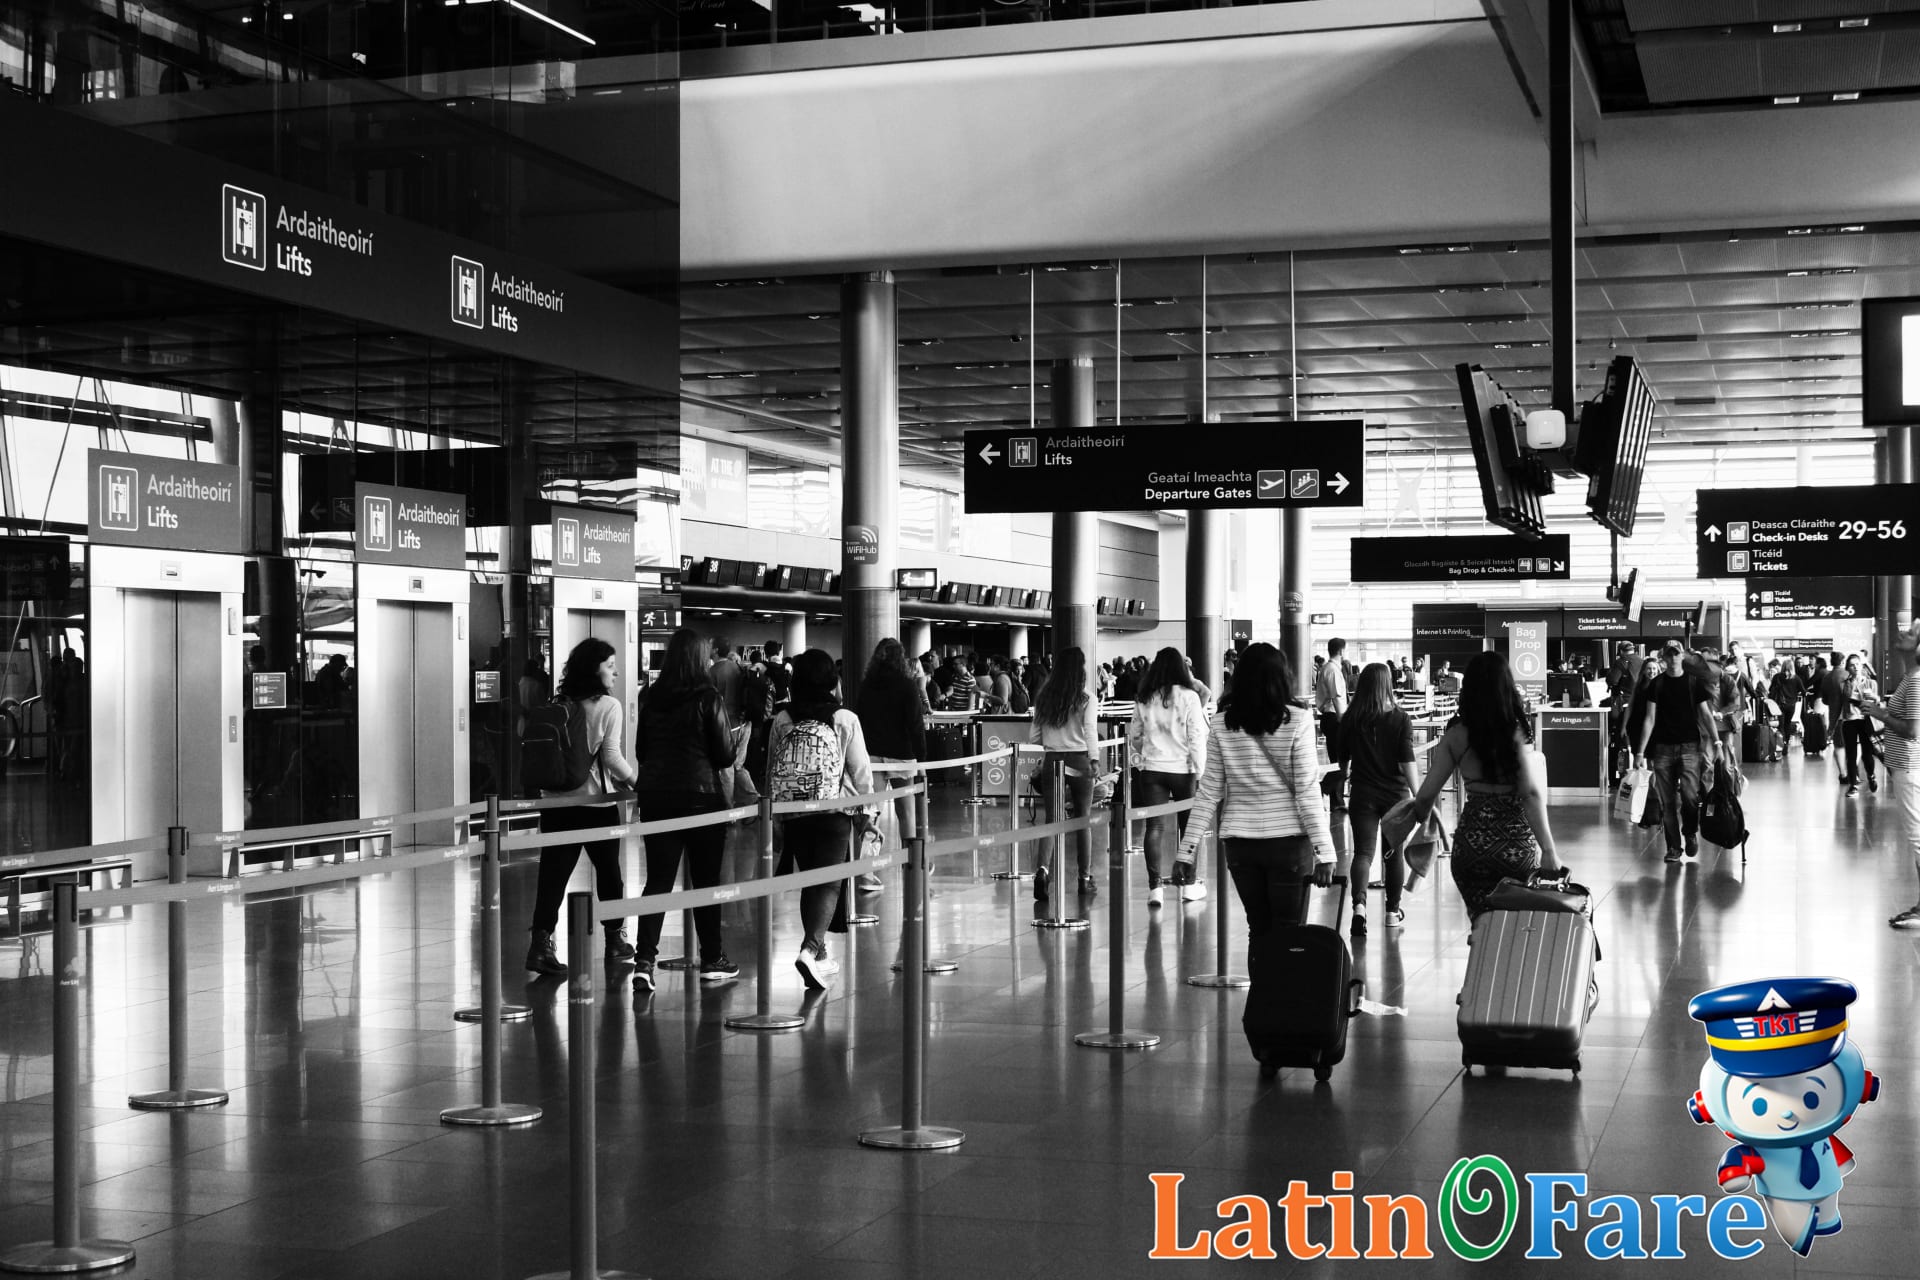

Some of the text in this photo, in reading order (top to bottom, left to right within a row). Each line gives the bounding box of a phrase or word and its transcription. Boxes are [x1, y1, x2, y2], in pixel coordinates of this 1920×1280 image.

[277, 205, 373, 256] Ardaitheoirí
[276, 243, 312, 276] Lifts
[491, 272, 564, 313] Ardaitheoirí
[491, 304, 518, 333] Lifts
[1046, 435, 1125, 449] Ardaitheoirí
[1045, 453, 1073, 466] Lifts
[1148, 470, 1253, 484] Geataí Imeachta
[147, 474, 231, 503] Ardaitheoirí
[1145, 486, 1253, 502] Departure Gates
[147, 505, 178, 529] Lifts
[398, 502, 459, 527] Ardaitheoirí
[1752, 519, 1836, 529] Deasca Cláraithe
[1838, 520, 1907, 540] 29-56
[398, 527, 421, 549] Lifts
[583, 523, 631, 545] Ardaitheoirí
[1752, 532, 1829, 542] Check-in Desks
[583, 545, 601, 564] Lifts
[1752, 548, 1783, 558] Ticéid
[682, 558, 692, 571] 37
[709, 559, 719, 573] 38
[757, 564, 766, 577] 39
[1448, 567, 1462, 575] Bag
[1463, 567, 1479, 575] Drop
[1752, 562, 1789, 571] Tickets
[1447, 629, 1471, 637] Printing
[1515, 627, 1537, 639] Bag
[1514, 639, 1541, 651] Drop
